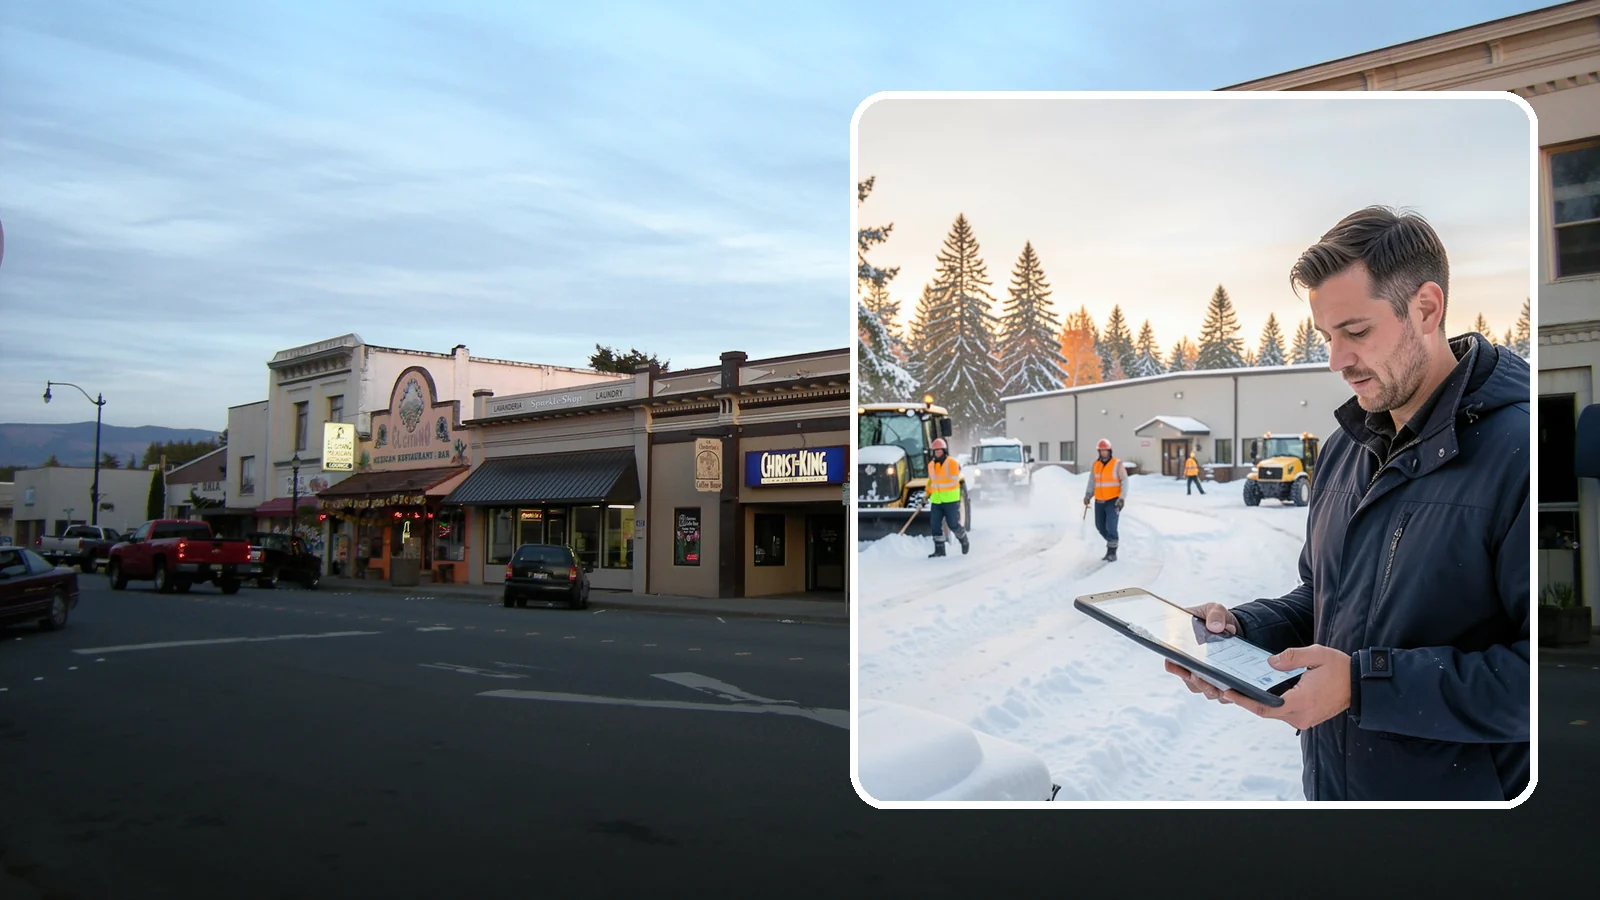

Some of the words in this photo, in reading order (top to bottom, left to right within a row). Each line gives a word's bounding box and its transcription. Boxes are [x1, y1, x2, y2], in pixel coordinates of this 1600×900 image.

[595, 389, 624, 400] LAUNDRY
[493, 402, 522, 412] LAVANDERIA
[530, 396, 560, 409] Sparkle
[561, 394, 582, 405] Shop
[397, 451, 433, 462] RESTAURANT
[437, 450, 450, 459] BAR
